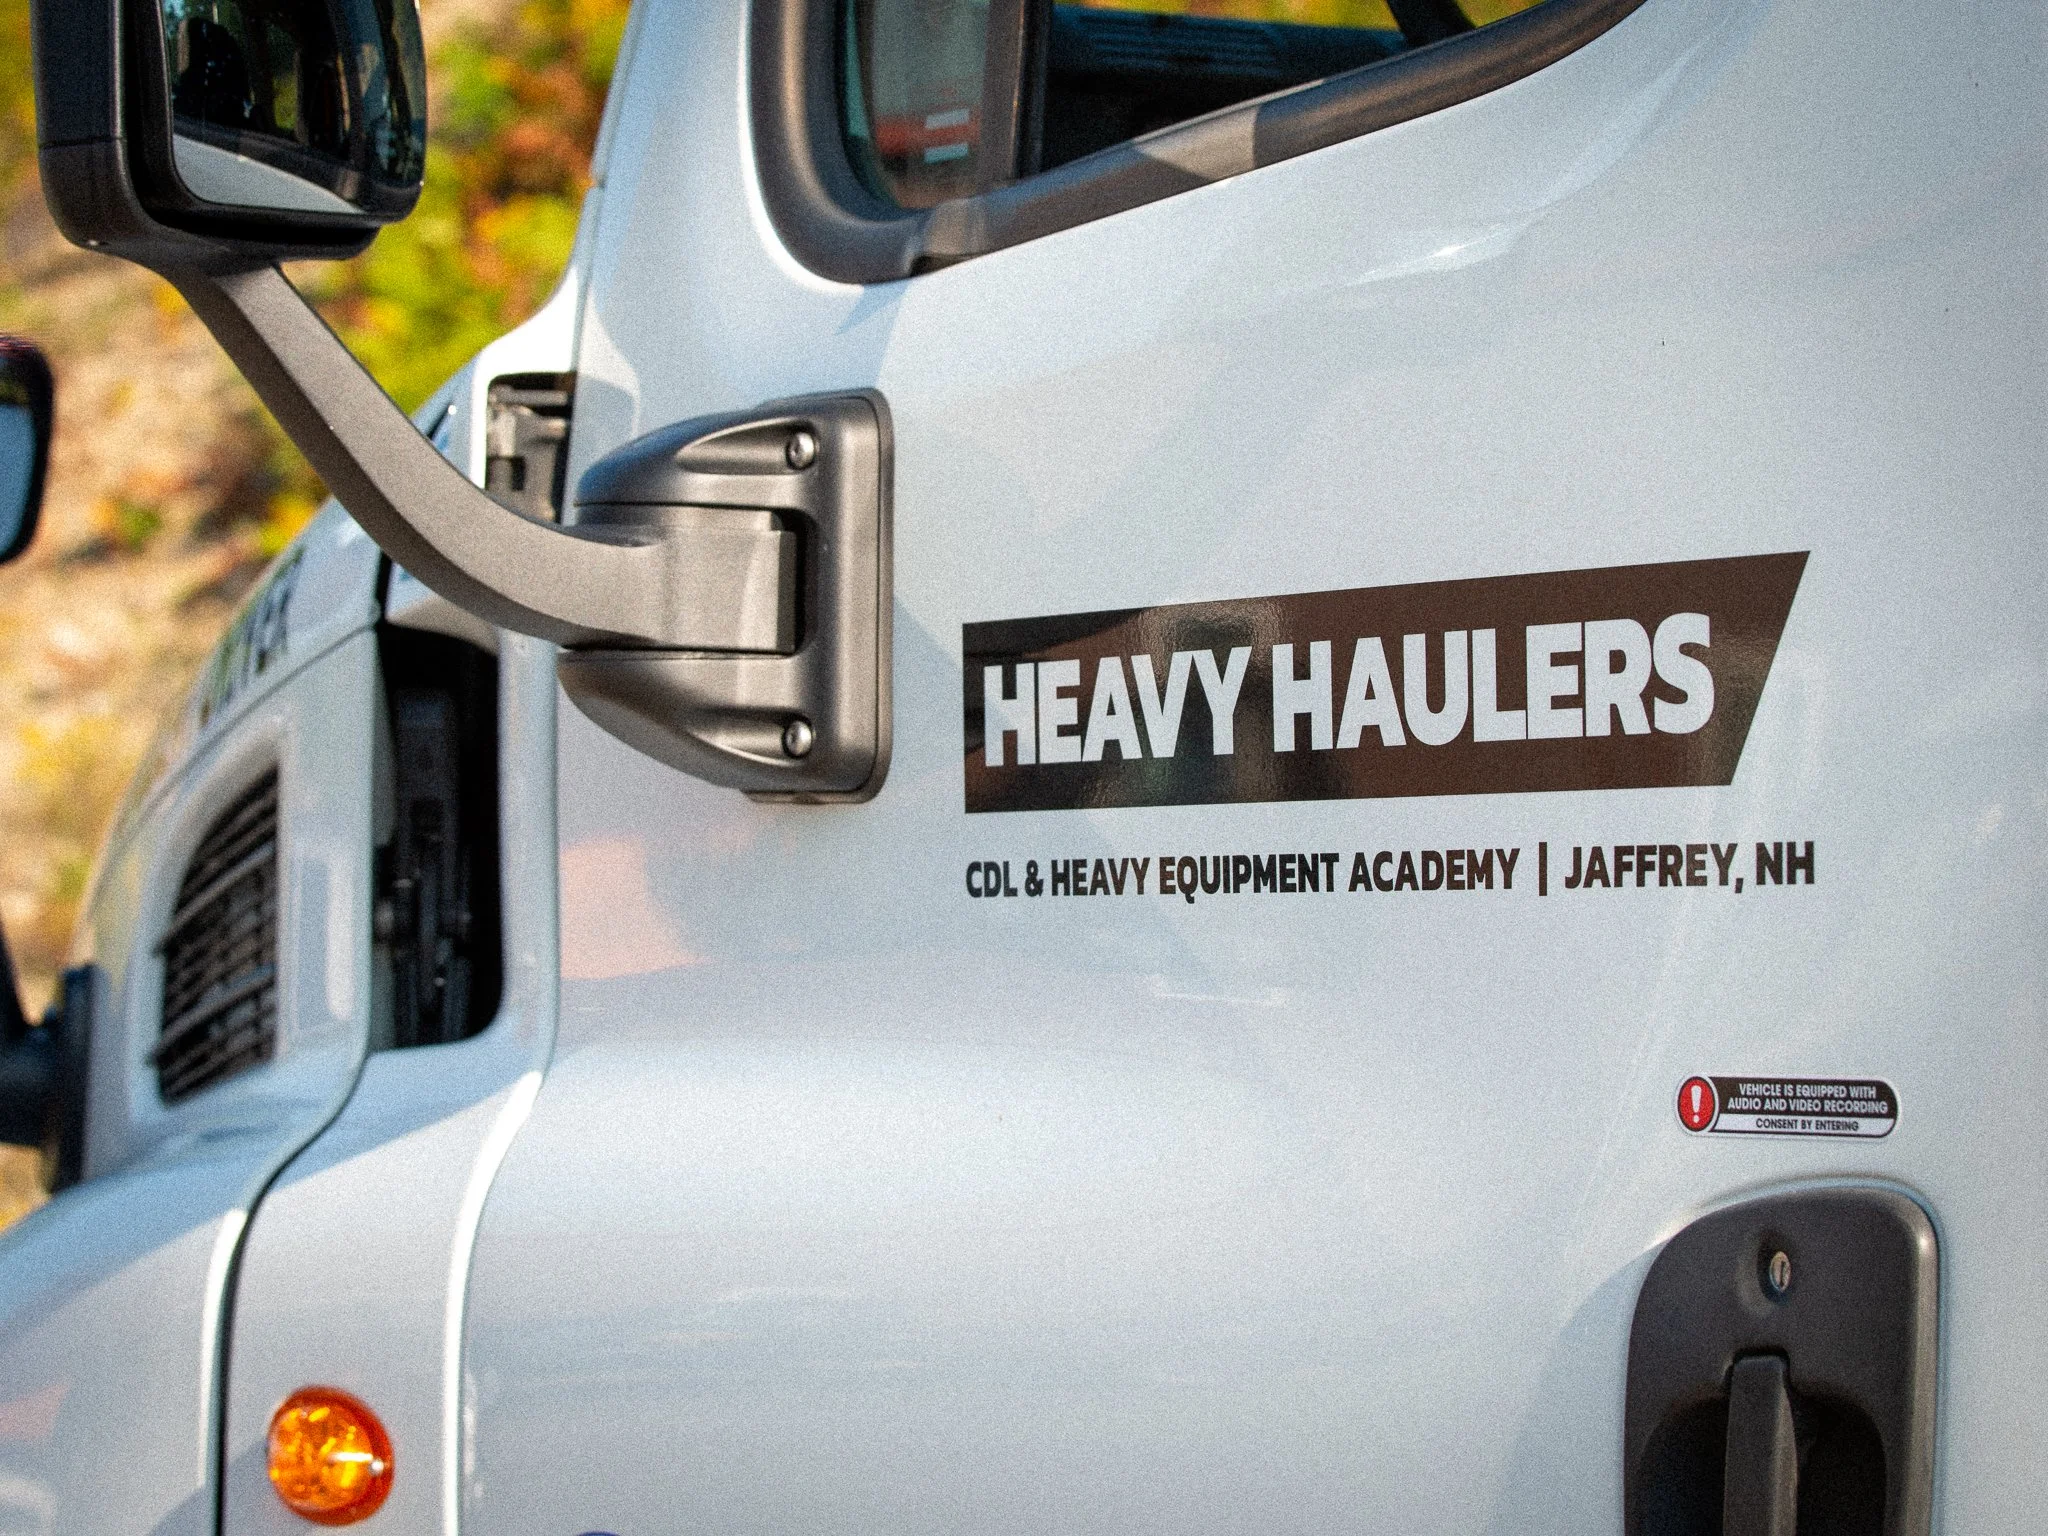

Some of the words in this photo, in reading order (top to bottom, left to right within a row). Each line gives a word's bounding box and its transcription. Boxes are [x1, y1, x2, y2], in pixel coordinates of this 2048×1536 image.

[984, 646, 1252, 767] HEAVY
[1272, 612, 1715, 752] HAULERS
[966, 860, 1018, 898] CDL
[1025, 860, 1044, 897] &
[1051, 857, 1150, 896] HEAVY
[1159, 852, 1339, 904] EQUIPMENT
[1348, 848, 1520, 892] ACADEMY
[1564, 842, 1744, 893] JAFFREY,
[1755, 841, 1815, 885] NH
[1739, 1083, 1782, 1096] VEHICLE
[1784, 1084, 1794, 1096] IS
[1796, 1084, 1847, 1098] EQUIPPED
[1849, 1086, 1876, 1099] WITH
[1727, 1098, 1761, 1110] AUDIO
[1764, 1098, 1787, 1111] AND
[1789, 1099, 1821, 1112] VIDEO
[1824, 1099, 1888, 1113] RECORDING
[1756, 1118, 1798, 1130] CONSENT
[1801, 1118, 1813, 1130] BY
[1815, 1118, 1859, 1131] ENTERING
